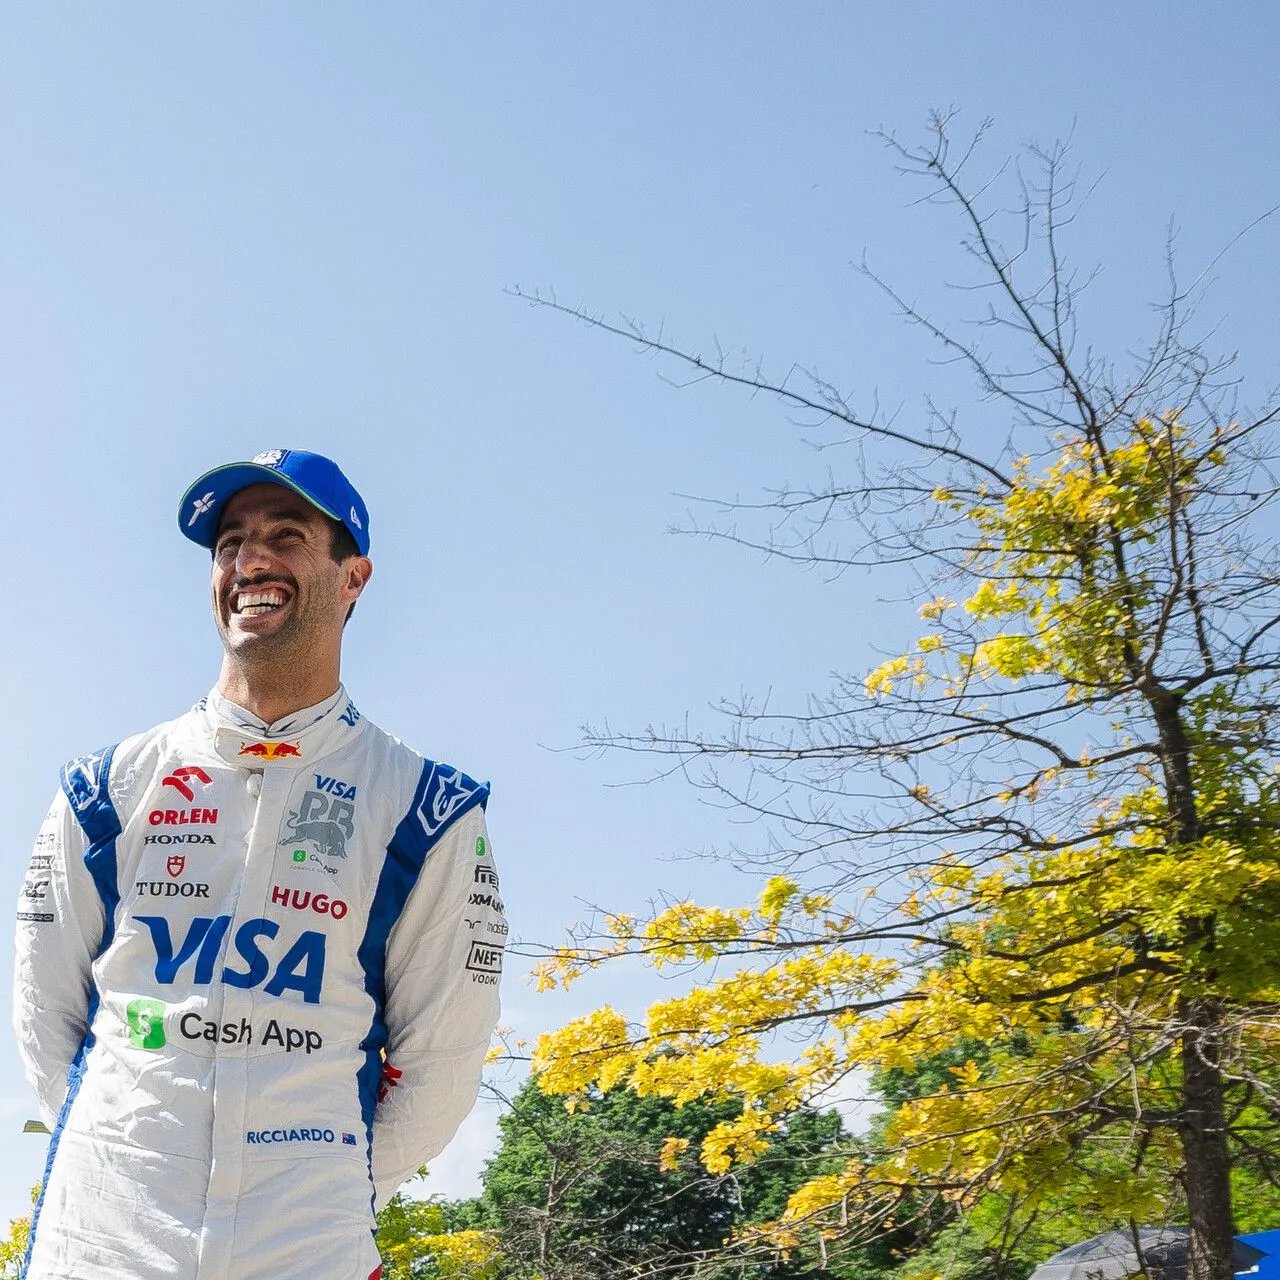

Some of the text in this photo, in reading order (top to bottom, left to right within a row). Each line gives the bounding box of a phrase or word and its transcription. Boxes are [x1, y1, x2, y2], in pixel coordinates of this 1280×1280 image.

[312, 773, 357, 801] VISA
[148, 808, 219, 827] ORLEN
[143, 833, 217, 847] HONDA
[135, 881, 210, 899] TUDOR
[271, 884, 348, 920] HUGO
[131, 914, 327, 1005] VISA
[473, 948, 503, 967] NEFT
[179, 1012, 253, 1045] Cash
[261, 1019, 323, 1055] App
[246, 1128, 335, 1145] RICCIARDO
